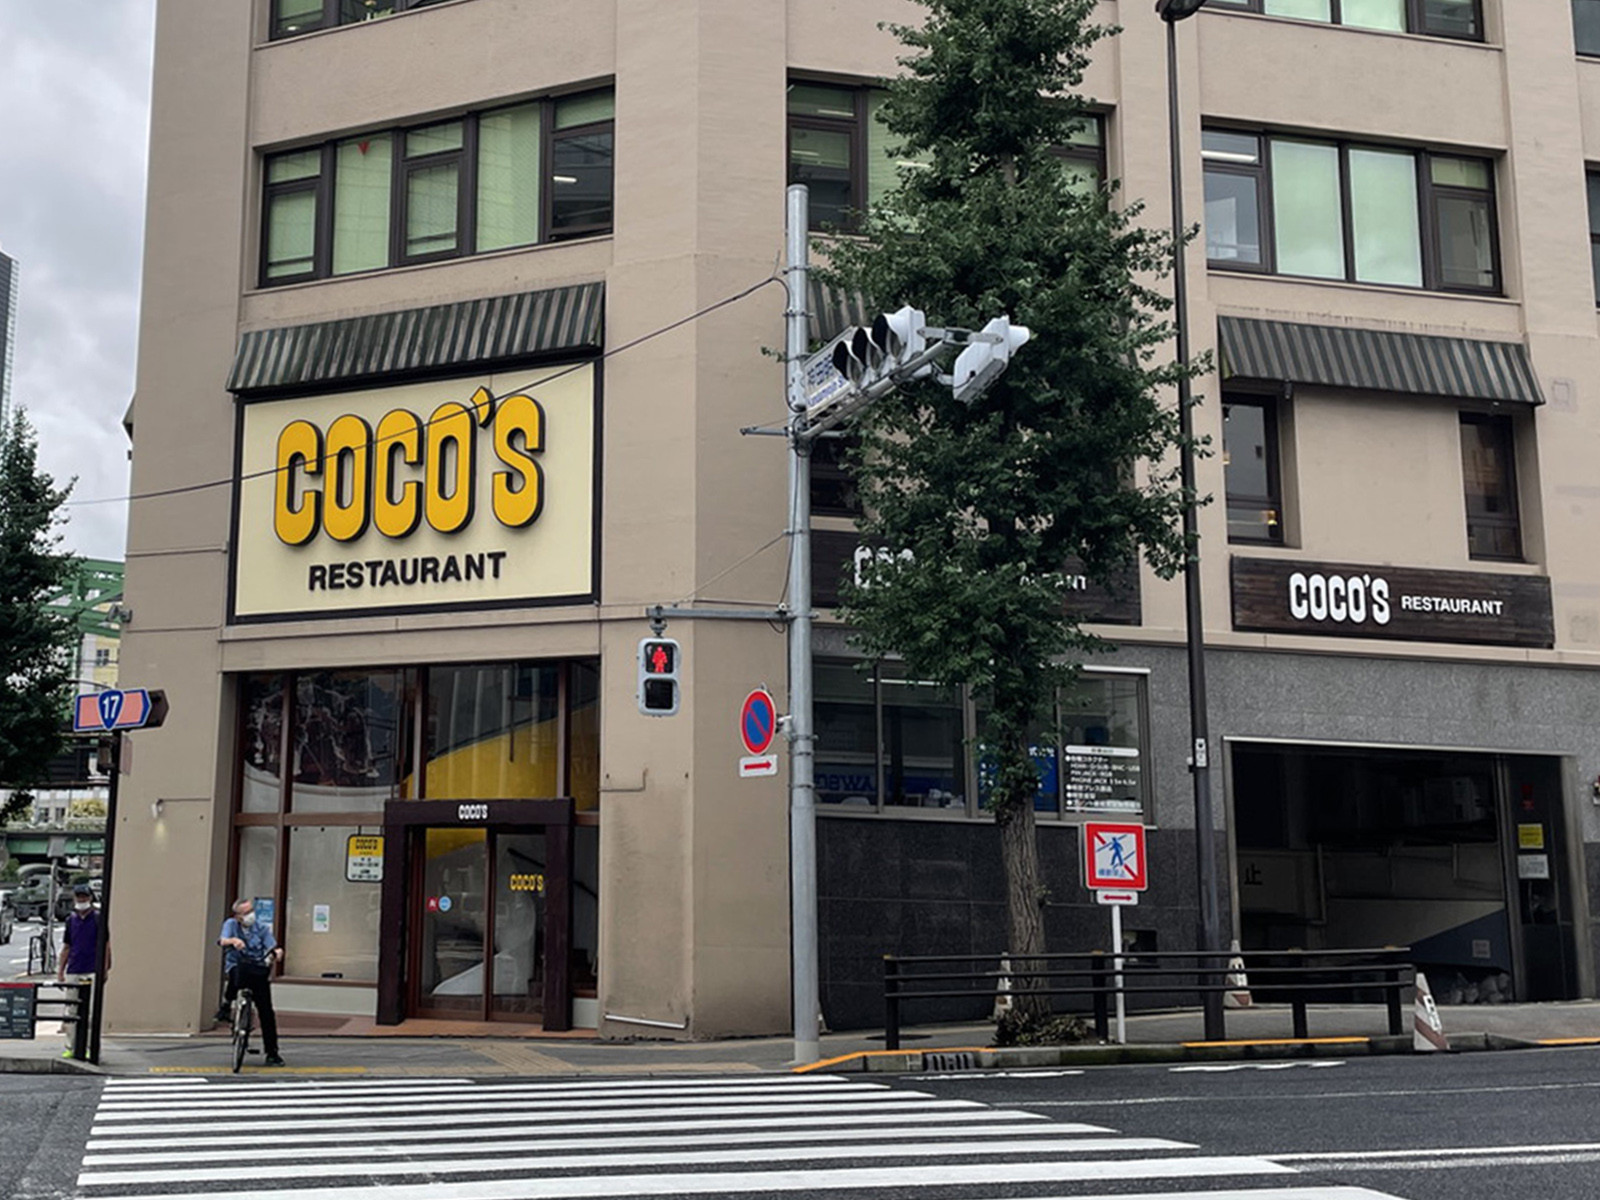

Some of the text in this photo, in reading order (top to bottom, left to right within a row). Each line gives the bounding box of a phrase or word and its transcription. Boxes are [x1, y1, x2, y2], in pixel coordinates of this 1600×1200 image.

[274, 386, 545, 546] COCO'S
[308, 551, 507, 592] RESTAURANT
[1289, 572, 1504, 624] COCO'S RESTAURANT
[103, 695, 120, 719] 17
[458, 804, 488, 819] COCO'S
[510, 874, 544, 891] COCO'S
